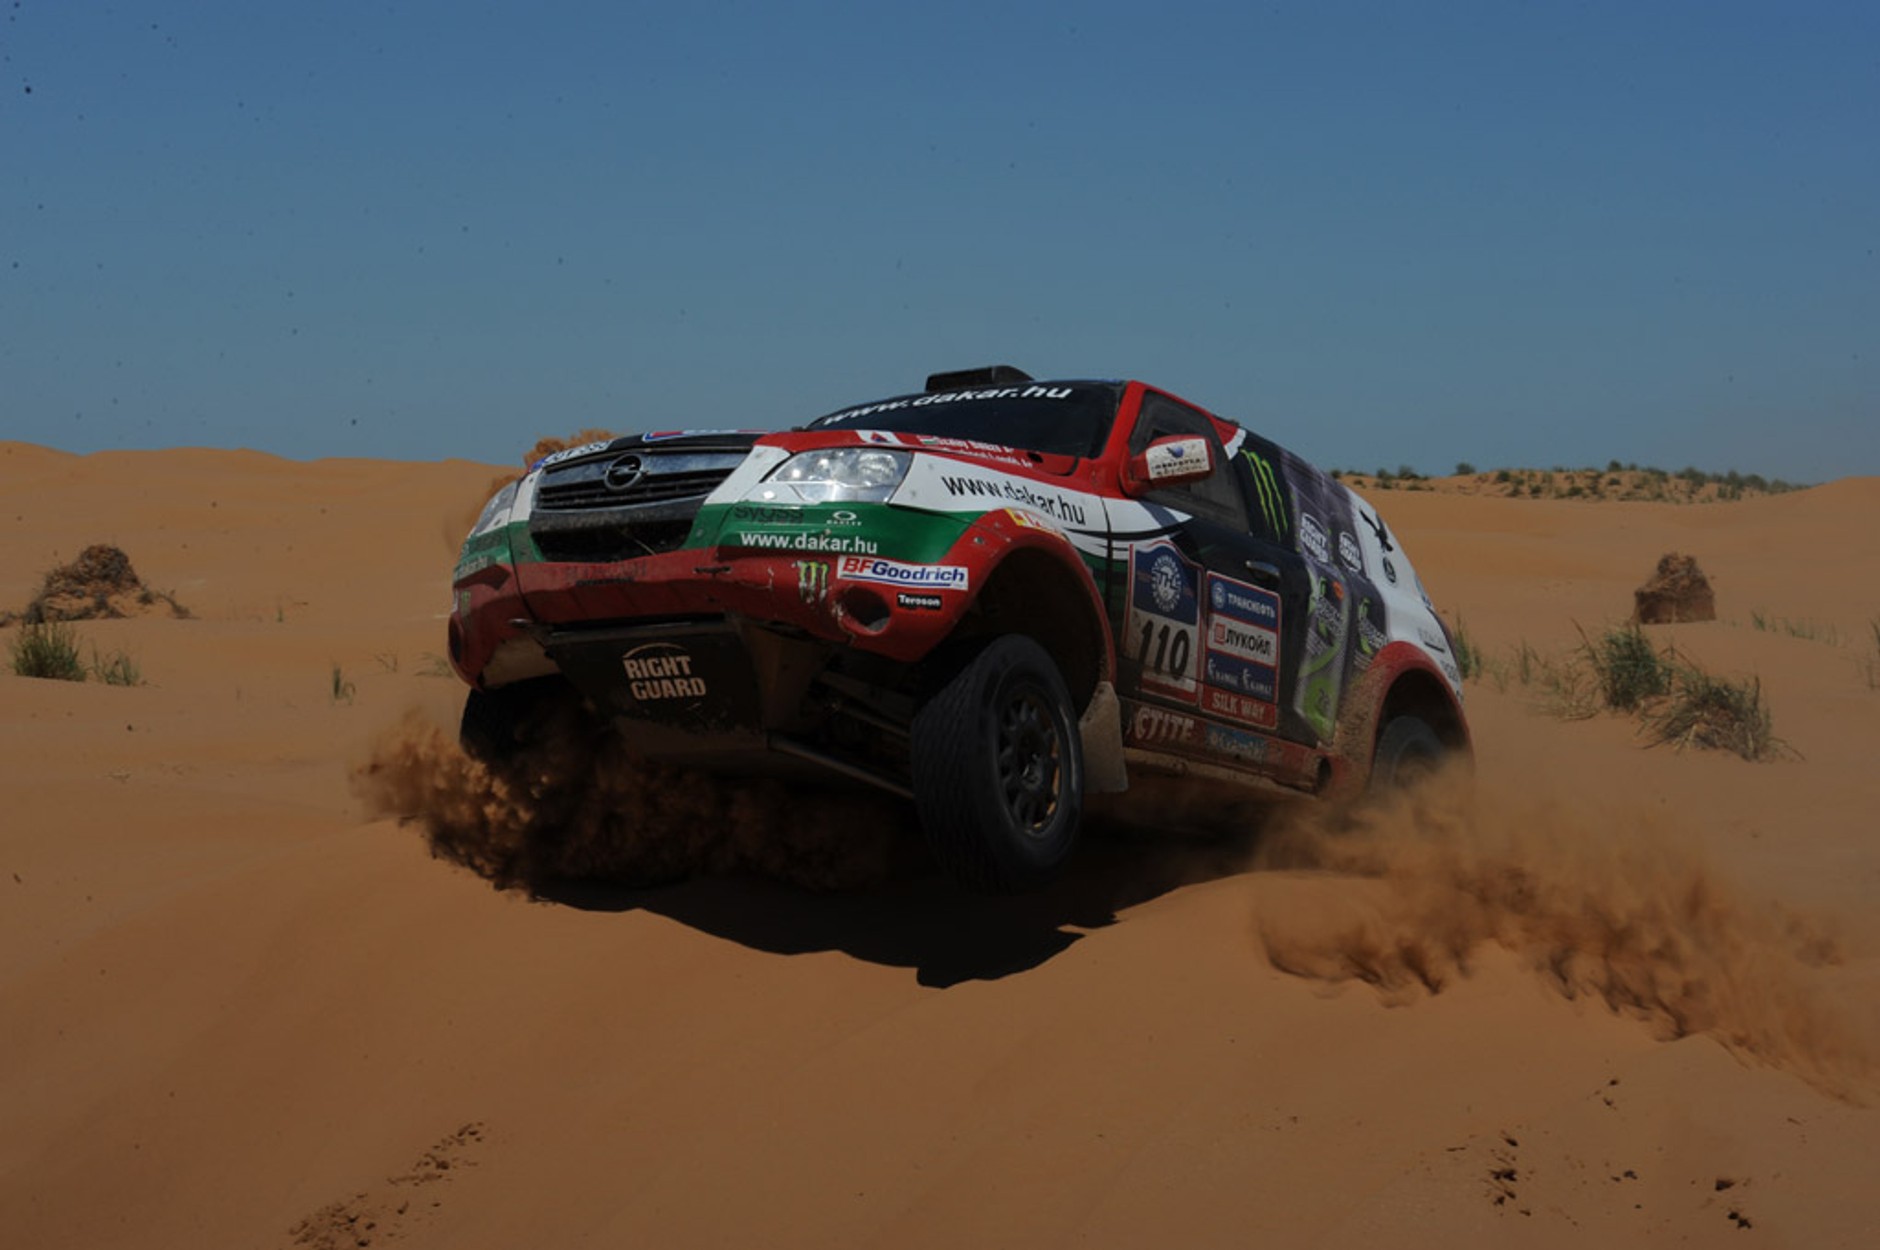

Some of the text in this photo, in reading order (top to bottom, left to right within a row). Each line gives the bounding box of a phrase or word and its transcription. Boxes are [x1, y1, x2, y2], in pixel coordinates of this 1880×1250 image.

[823, 385, 1074, 426] www.dakar.hu
[941, 475, 1087, 527] www.dakar.hu
[740, 532, 878, 555] www.dakar.hu
[843, 557, 965, 583] BFGoodrich
[897, 594, 941, 608] Teroson
[1138, 620, 1190, 681] 110
[1226, 628, 1272, 656] ЛУКОЙЛ
[622, 654, 692, 679] RIGHT
[629, 676, 707, 701] GUARD
[1211, 691, 1239, 715] SILK
[1125, 705, 1195, 742] CTITE
